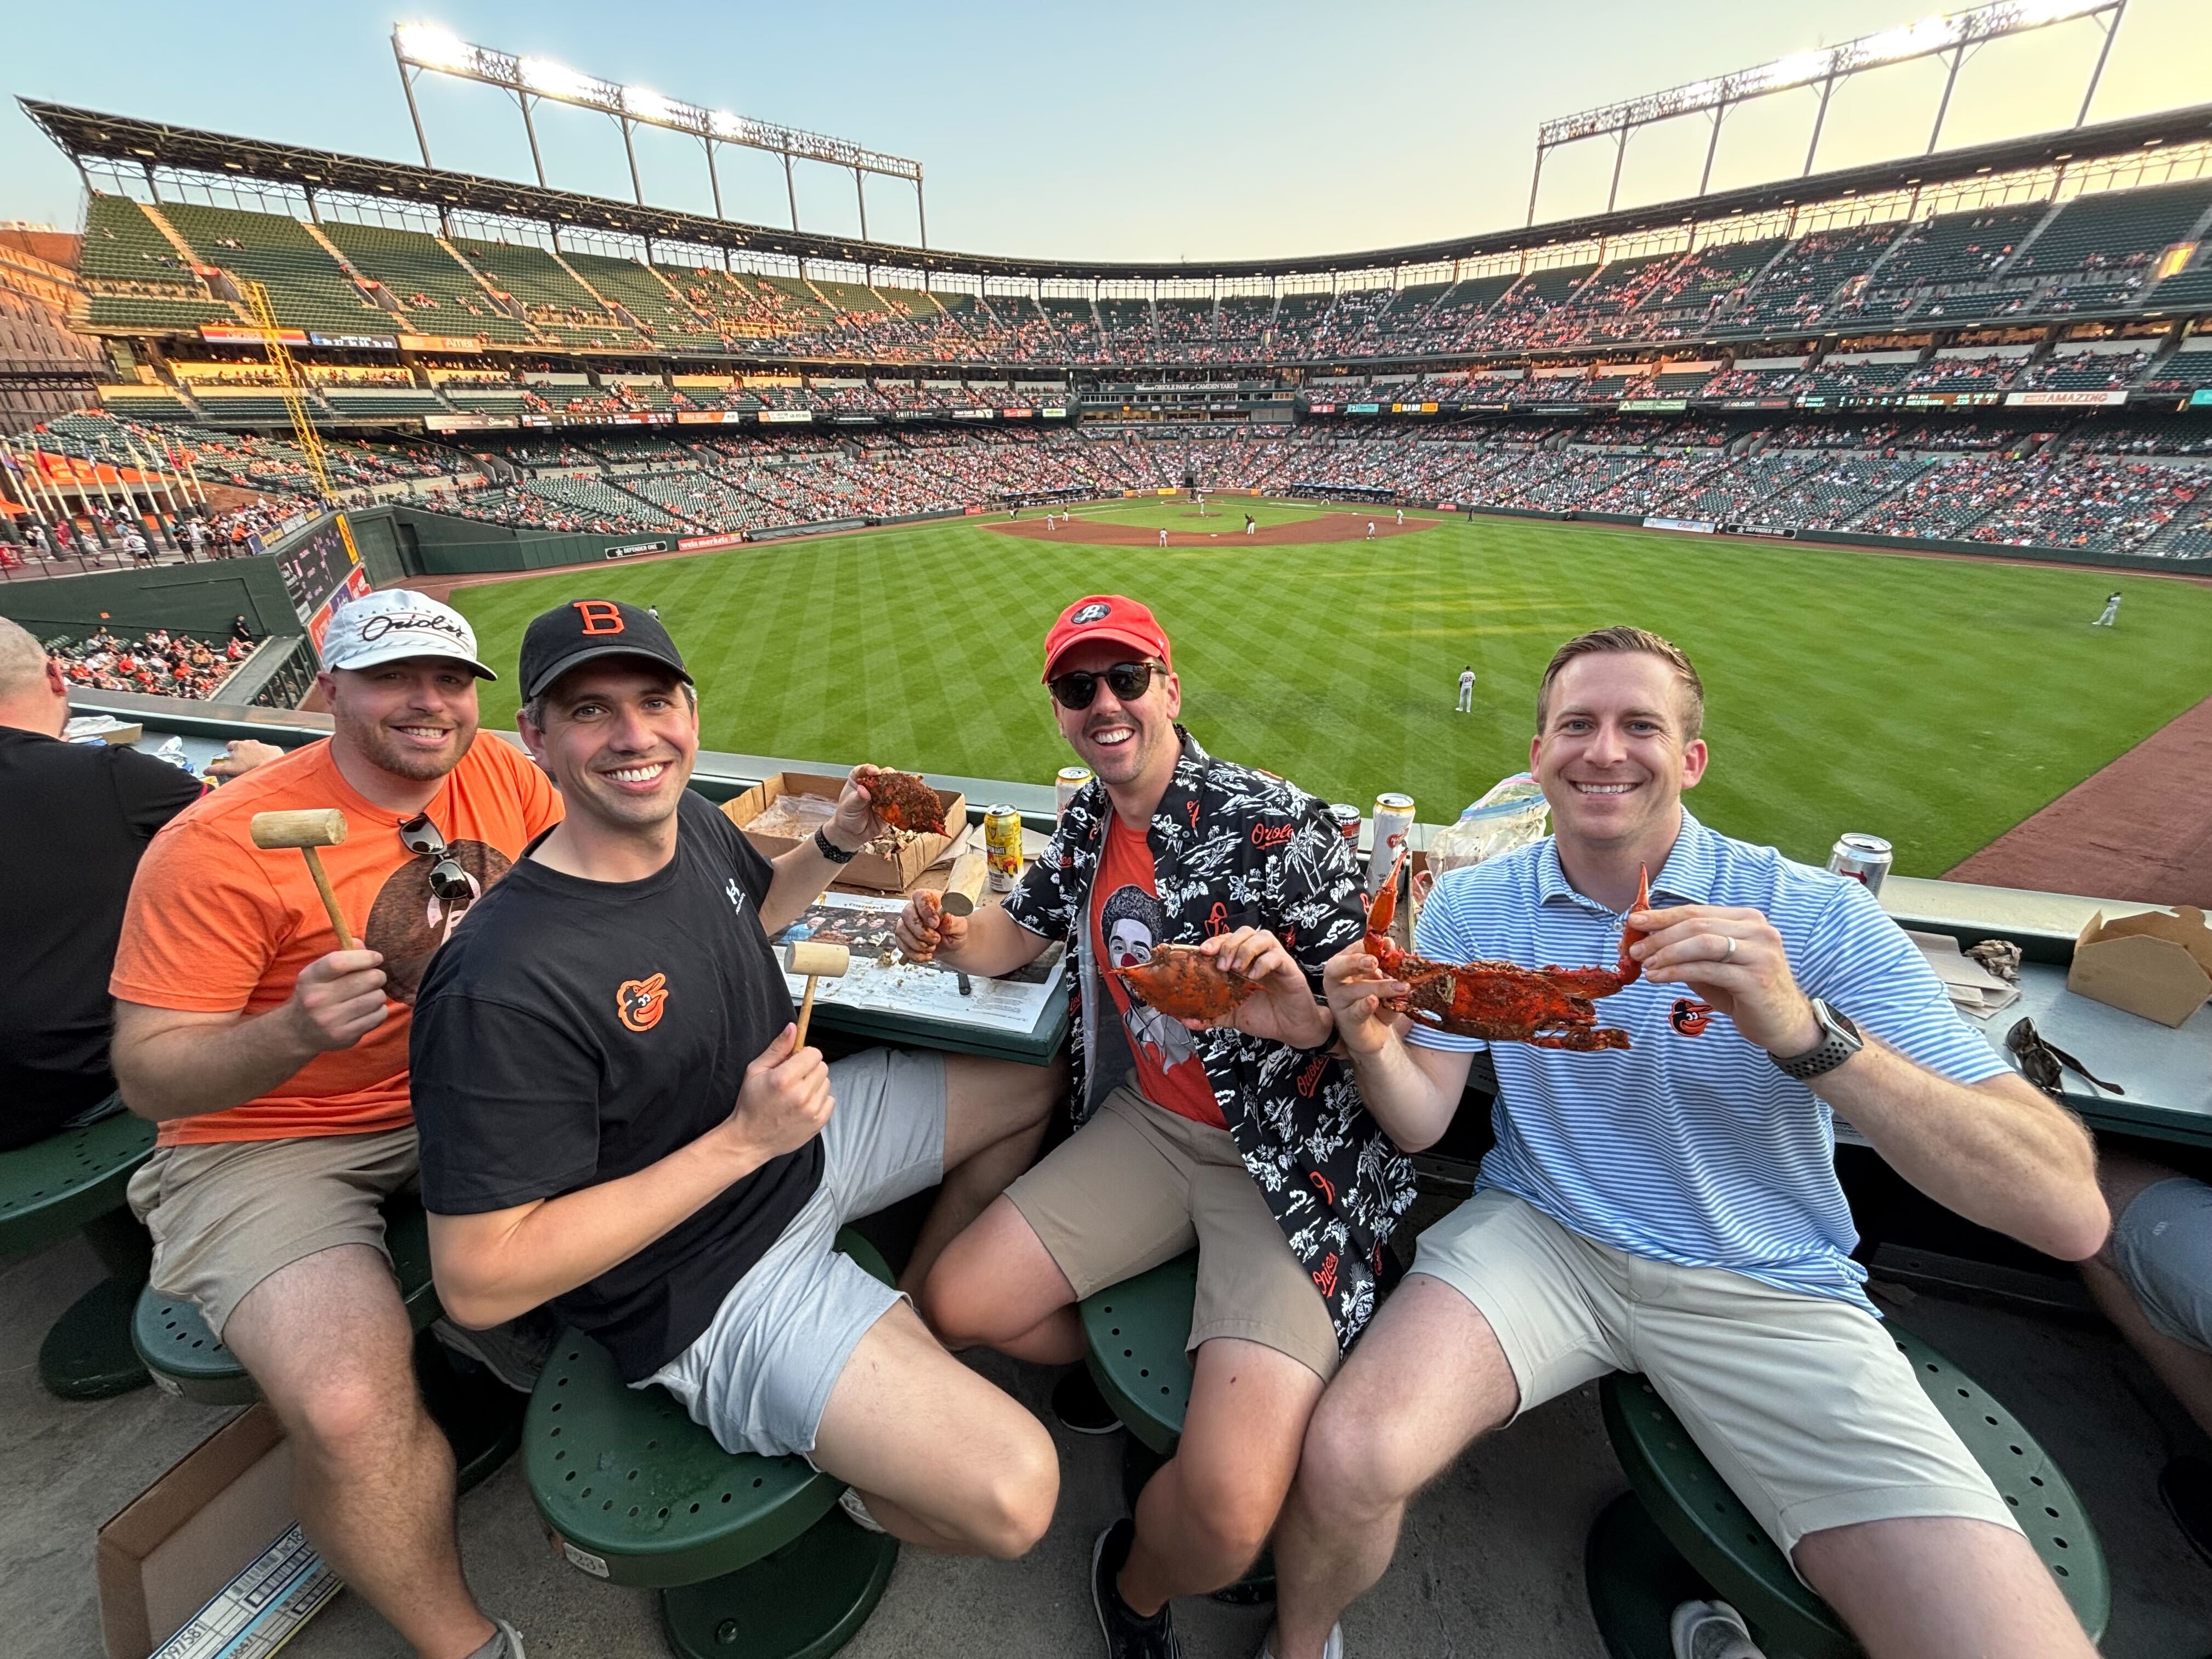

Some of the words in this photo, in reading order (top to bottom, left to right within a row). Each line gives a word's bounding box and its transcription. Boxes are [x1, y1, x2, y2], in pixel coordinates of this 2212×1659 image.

[2046, 393, 2108, 402] AMAZING
[698, 536, 729, 546] markets
[573, 601, 625, 635] B
[363, 615, 466, 641] Orioles
[1251, 823, 1294, 850] Oriole
[995, 847, 1006, 855] GATE
